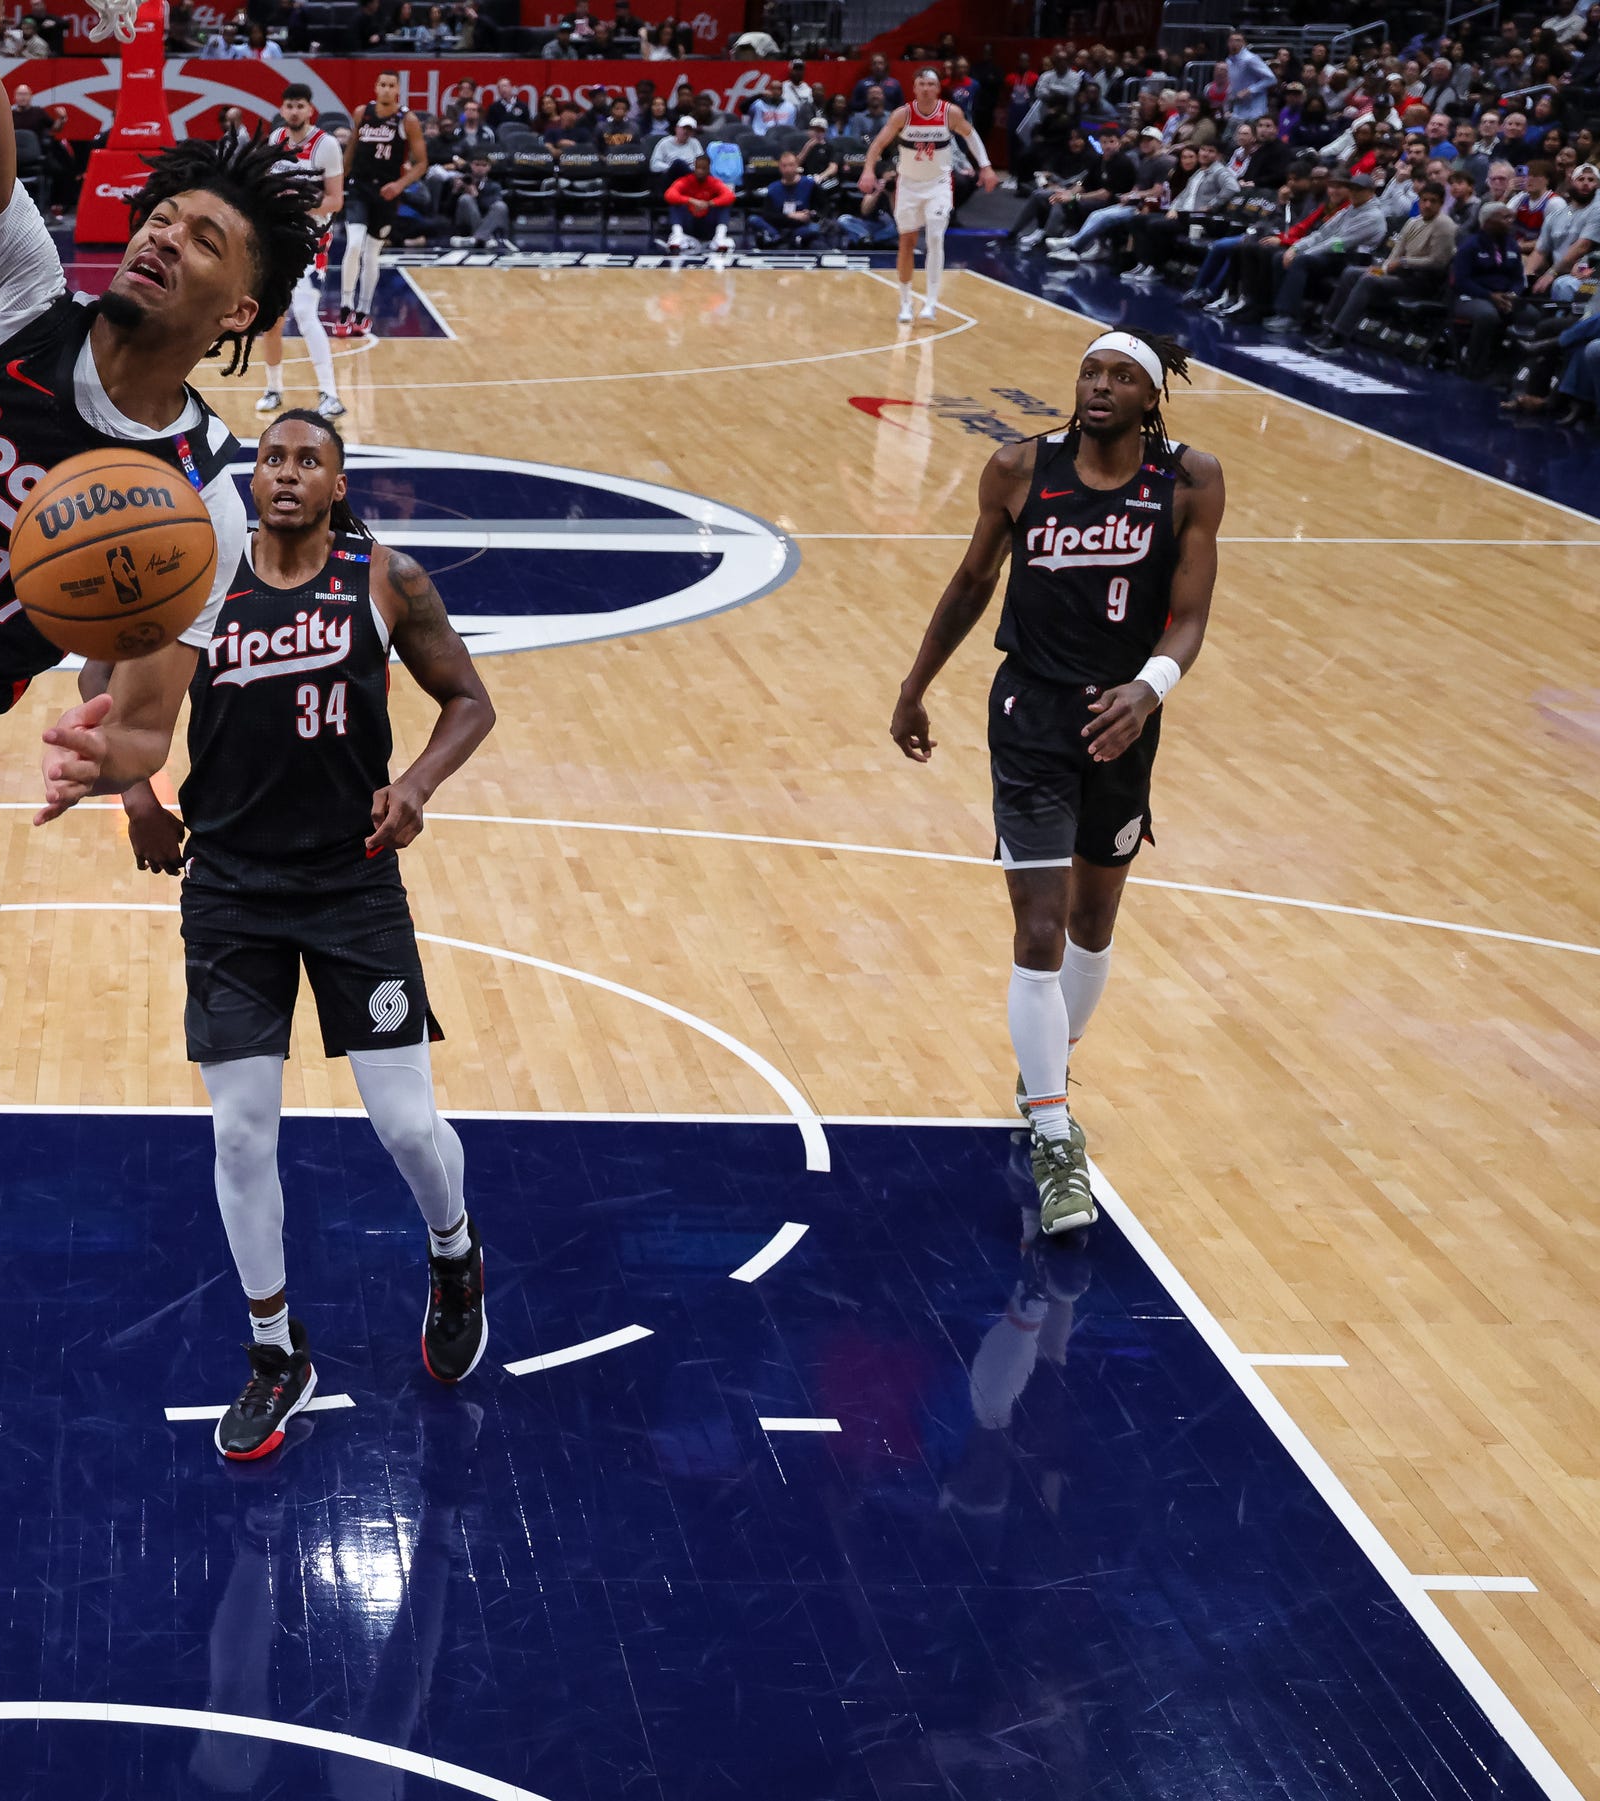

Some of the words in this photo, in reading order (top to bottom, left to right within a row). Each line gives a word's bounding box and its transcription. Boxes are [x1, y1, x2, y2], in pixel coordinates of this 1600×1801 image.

[35, 483, 176, 540] Wilson
[1125, 498, 1162, 511] BRIGHTSIDE
[344, 552, 357, 562] 32
[1026, 512, 1156, 573] ripcity
[315, 592, 358, 603] BRIGHTSIDE
[1107, 577, 1130, 623] 9
[207, 607, 352, 688] ripcity
[296, 681, 348, 739] 34
